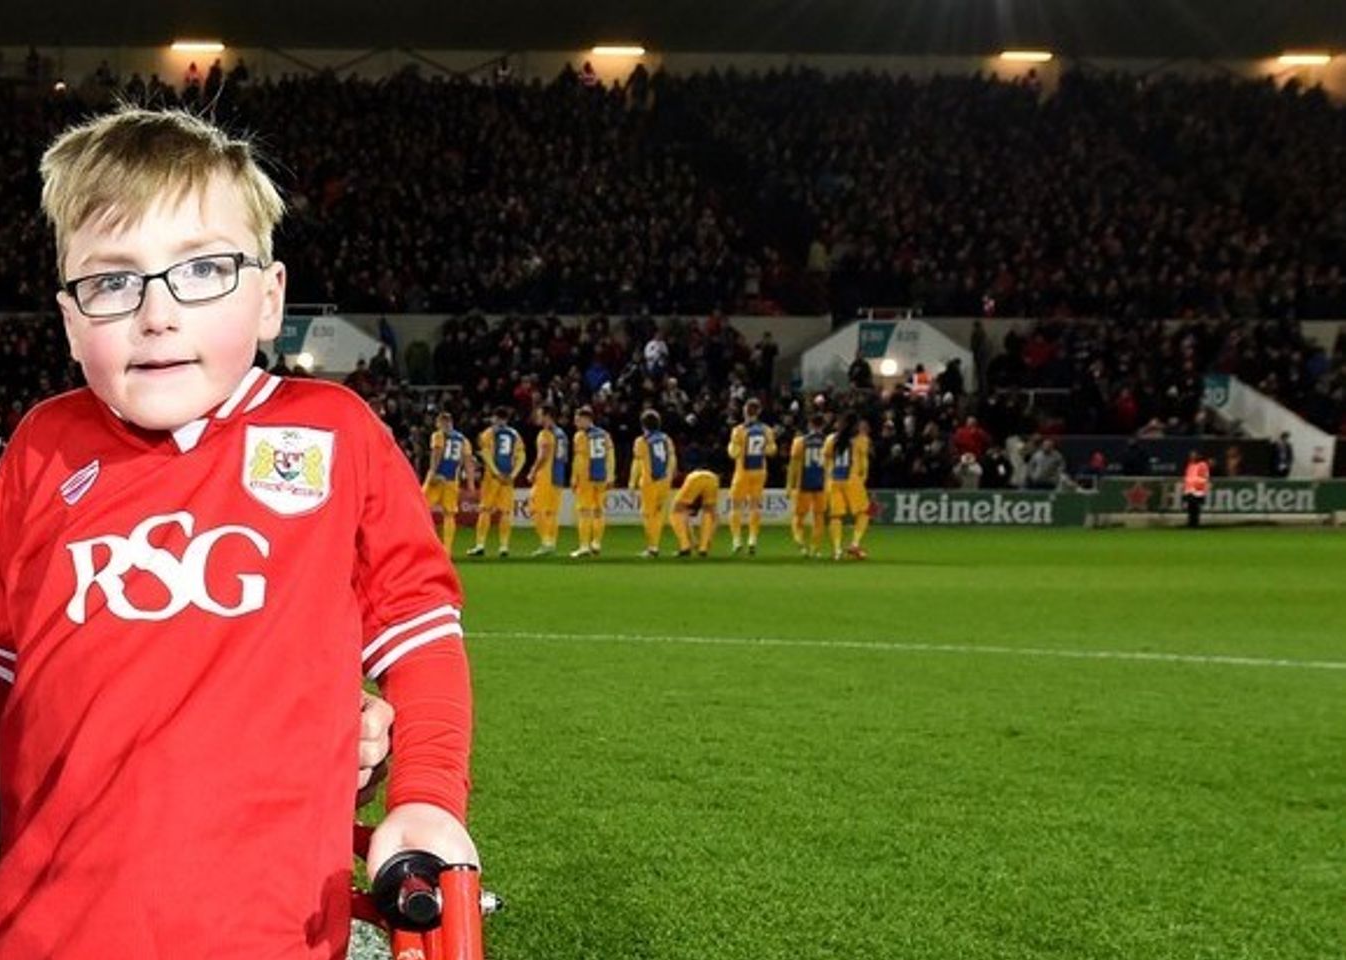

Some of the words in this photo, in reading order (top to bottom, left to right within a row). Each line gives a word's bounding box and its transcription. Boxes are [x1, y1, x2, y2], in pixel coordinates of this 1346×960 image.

[443, 438, 464, 461] 13
[498, 433, 512, 455] 3
[589, 437, 607, 459] 15
[653, 440, 667, 463] 4
[893, 493, 1053, 524] Heineken
[1160, 482, 1316, 512] Hineken
[65, 511, 271, 625] RSG
